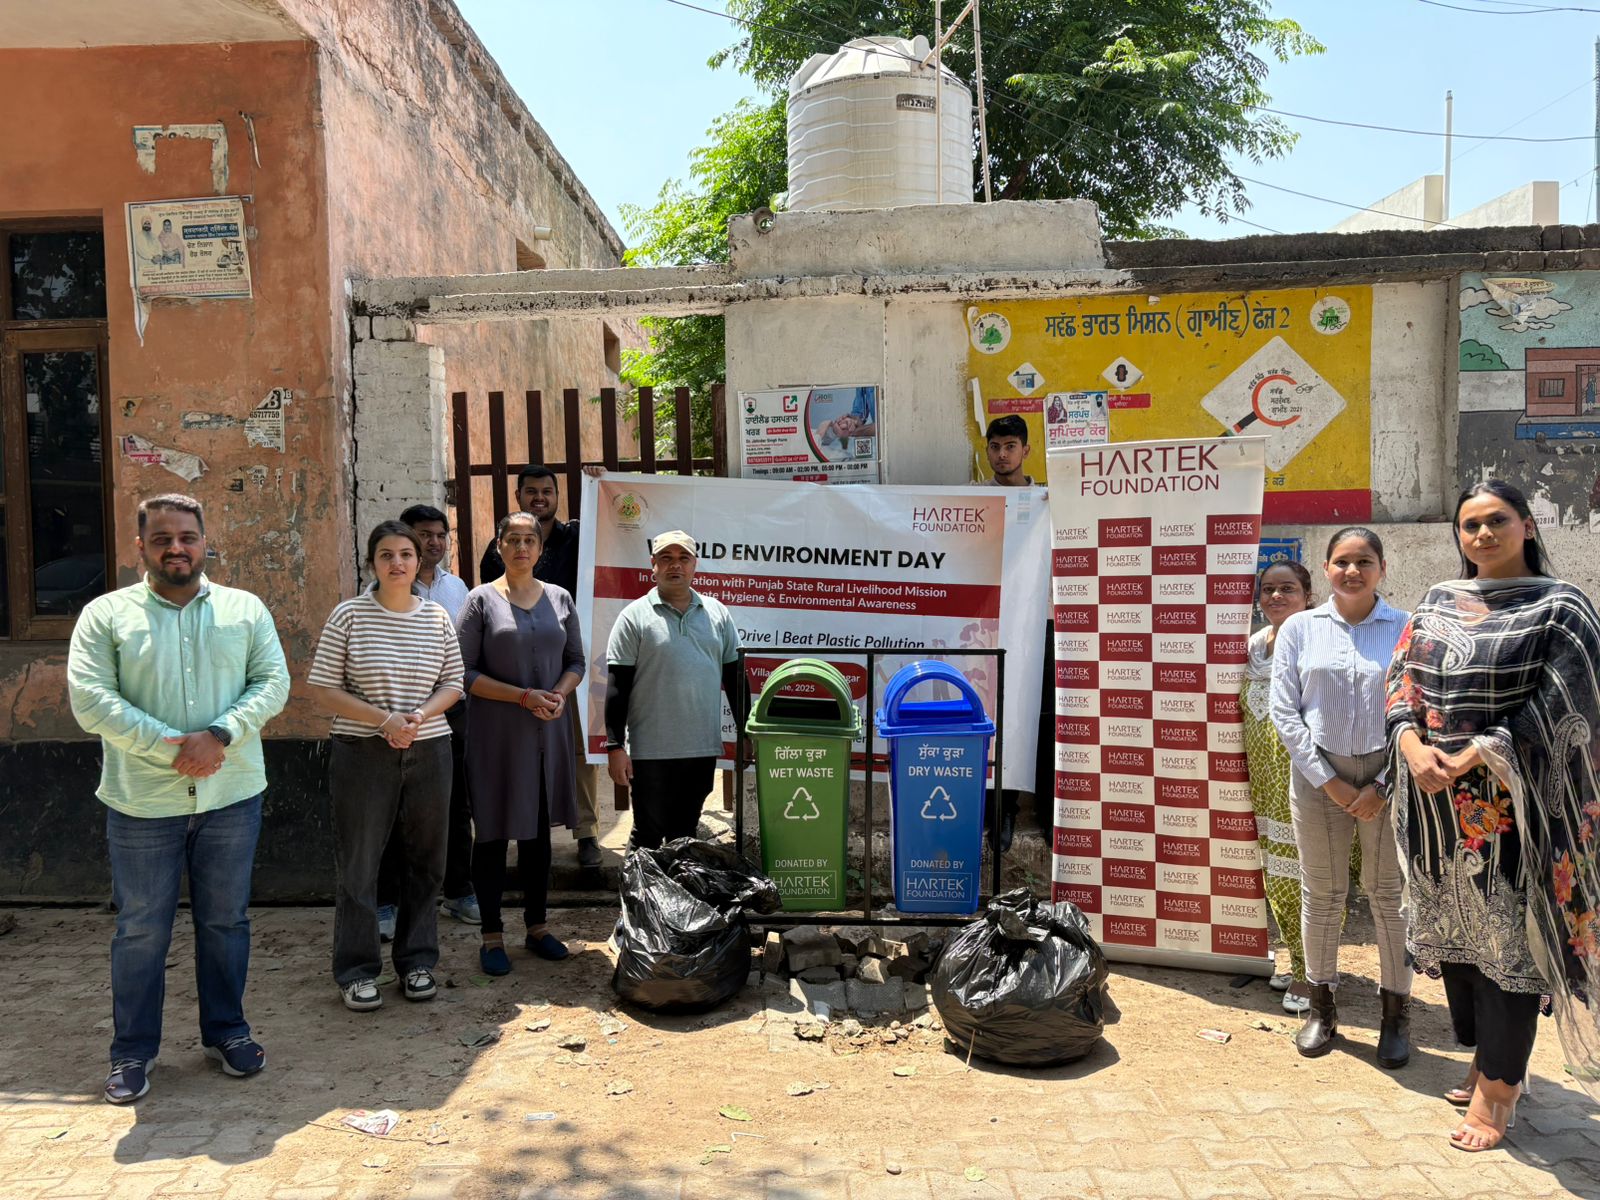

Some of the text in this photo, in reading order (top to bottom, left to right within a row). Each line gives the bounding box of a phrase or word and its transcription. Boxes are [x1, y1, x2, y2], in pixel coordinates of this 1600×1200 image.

[1082, 313, 1120, 336] ਭਾਰਤ
[1279, 307, 1290, 328] 2
[1080, 444, 1219, 477] HARTEK
[1080, 474, 1220, 496] FOUNDATION
[912, 507, 985, 523] HARTEK
[912, 522, 985, 533] FOUNDATION
[1106, 525, 1142, 534] HARTEK
[1160, 524, 1194, 532] HARTEK
[1214, 522, 1253, 531] HARTEK
[732, 544, 891, 568] ENVIRONMENT
[898, 552, 946, 570] DAY
[1056, 555, 1088, 564] HARTEK
[1106, 554, 1140, 562] HARTEK
[1160, 553, 1196, 561] HARTEK
[639, 572, 648, 582] In
[722, 577, 745, 588] with
[748, 578, 784, 592] Punjab
[787, 580, 814, 591] State
[816, 581, 844, 592] Rural
[847, 582, 902, 596] Livelihood
[905, 586, 947, 598] Mission
[722, 590, 764, 604] Hygiene
[767, 593, 776, 603] &
[779, 594, 855, 607] Environmental
[858, 598, 916, 610] Awareness
[738, 628, 924, 649] Drive Beat Plastic Pollution
[1057, 667, 1089, 676] HARTEK
[1108, 668, 1140, 676] HARTEK
[1160, 670, 1196, 679] HARTEK
[795, 684, 815, 692] 2025
[1108, 696, 1143, 705] HARTEK
[1057, 722, 1090, 732] HARTEK
[1108, 725, 1141, 733] HARTEK
[1161, 727, 1197, 736] HARTEK
[774, 746, 802, 760] ਗਿੱਲਾ
[918, 744, 940, 760] ਸੁੱਕਾ
[1108, 752, 1144, 761] HARTEK
[769, 767, 834, 778] WET WASTE
[908, 766, 972, 778] DRY WASTE
[1057, 777, 1090, 787] HARTEK
[1109, 780, 1142, 790] HARTEK
[1162, 784, 1199, 794] HARTEK
[1109, 808, 1144, 818] HARTEK
[1110, 837, 1143, 847] HARTEK
[1164, 842, 1200, 851] HARTEK
[775, 859, 828, 868] DONATED BY
[911, 860, 964, 869] DONATED BY
[1110, 865, 1146, 875] HARTEK
[772, 876, 830, 887] HARTEK
[906, 876, 965, 889] HARTEK
[1218, 874, 1256, 885] HARTEK
[1218, 881, 1256, 890] FOUNDATION
[776, 886, 830, 896] OUNDATION
[906, 888, 965, 899] FOUNDATION
[1110, 894, 1144, 904] HARTEK
[1164, 898, 1201, 908] HARTEK
[1110, 922, 1146, 932] HARTEK
[1219, 931, 1257, 942] HARTEK
[1219, 938, 1258, 947] FOUNDATION
